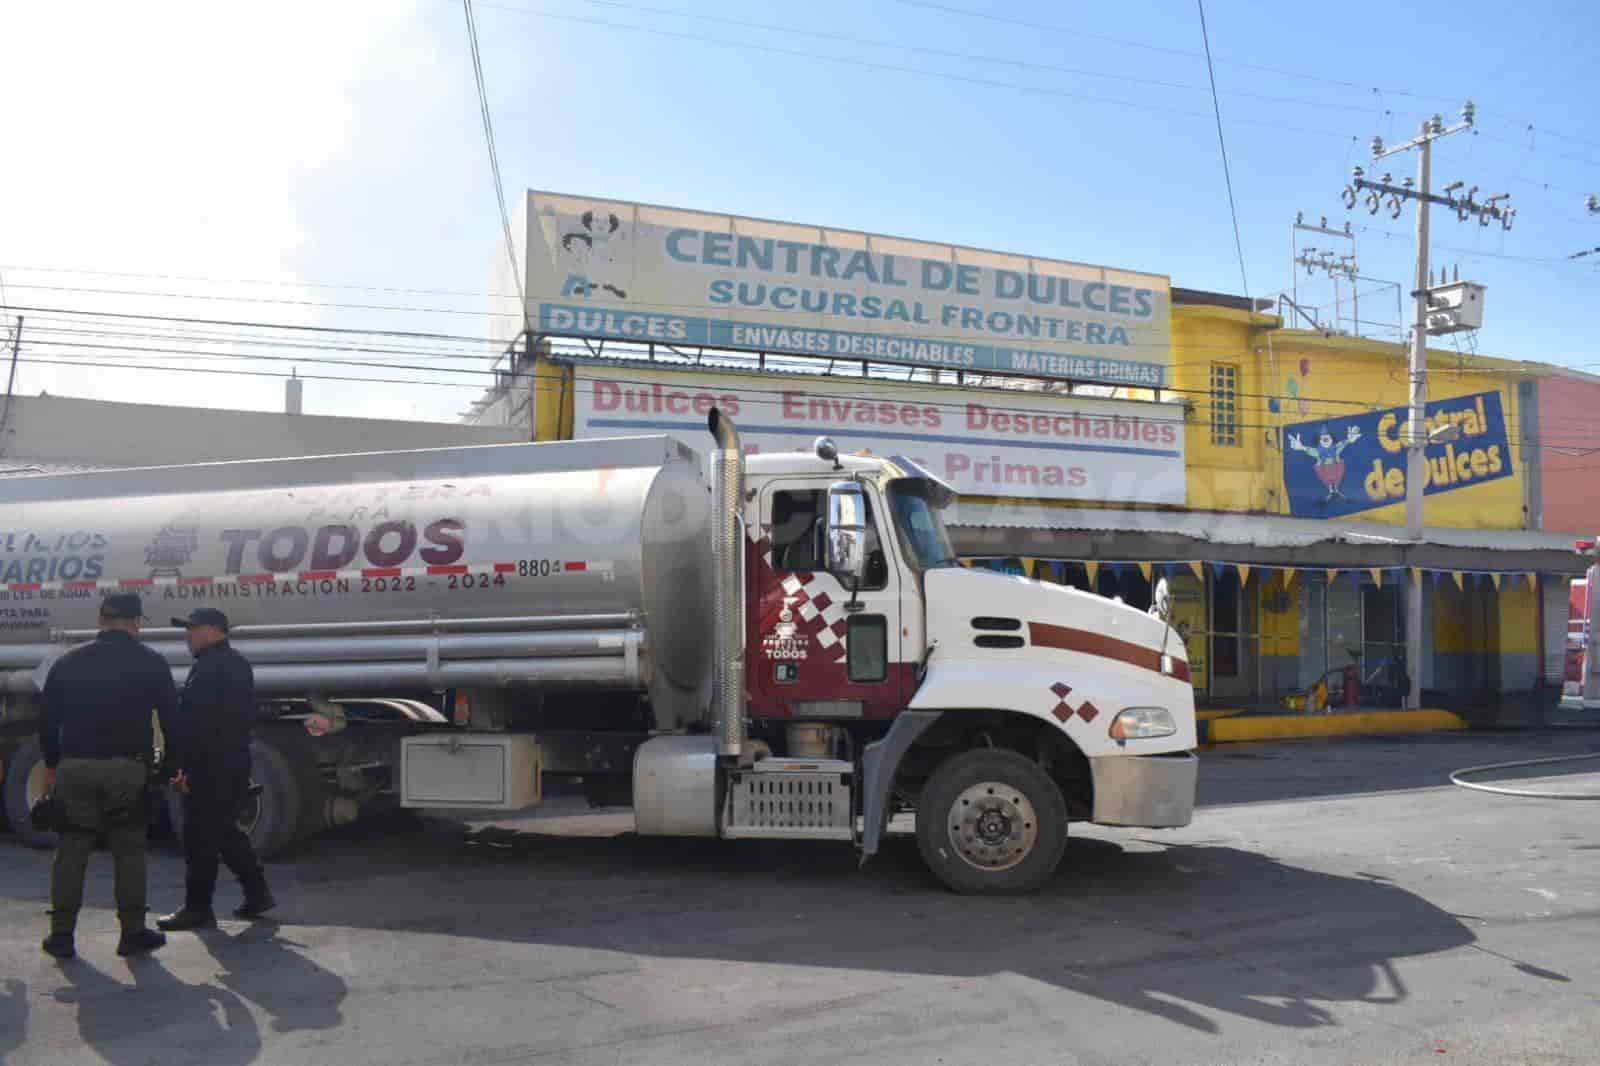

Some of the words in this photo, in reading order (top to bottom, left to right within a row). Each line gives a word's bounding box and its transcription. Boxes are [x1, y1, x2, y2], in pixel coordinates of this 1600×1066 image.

[665, 228, 906, 286] CENTRAL
[921, 258, 981, 295] DE
[995, 269, 1153, 317] DULCES
[551, 308, 686, 339] DULCES
[709, 280, 930, 324] SUCURSAL
[941, 305, 1129, 346] FRONTERA
[732, 327, 829, 351] ENVASES
[836, 335, 975, 364] DESECHABLES
[1011, 352, 1095, 378] MATERIAS
[1101, 363, 1160, 384] PRIMAS
[592, 380, 740, 417] Dulces
[782, 390, 942, 428] Envases
[966, 402, 1177, 445] Desechables
[945, 453, 1088, 487] Primas
[1365, 459, 1405, 501] de
[220, 517, 466, 576] TODOS
[361, 576, 417, 593] 2022
[447, 572, 507, 590] 2024
[518, 559, 561, 577] 8804
[765, 649, 808, 659] TODOS
